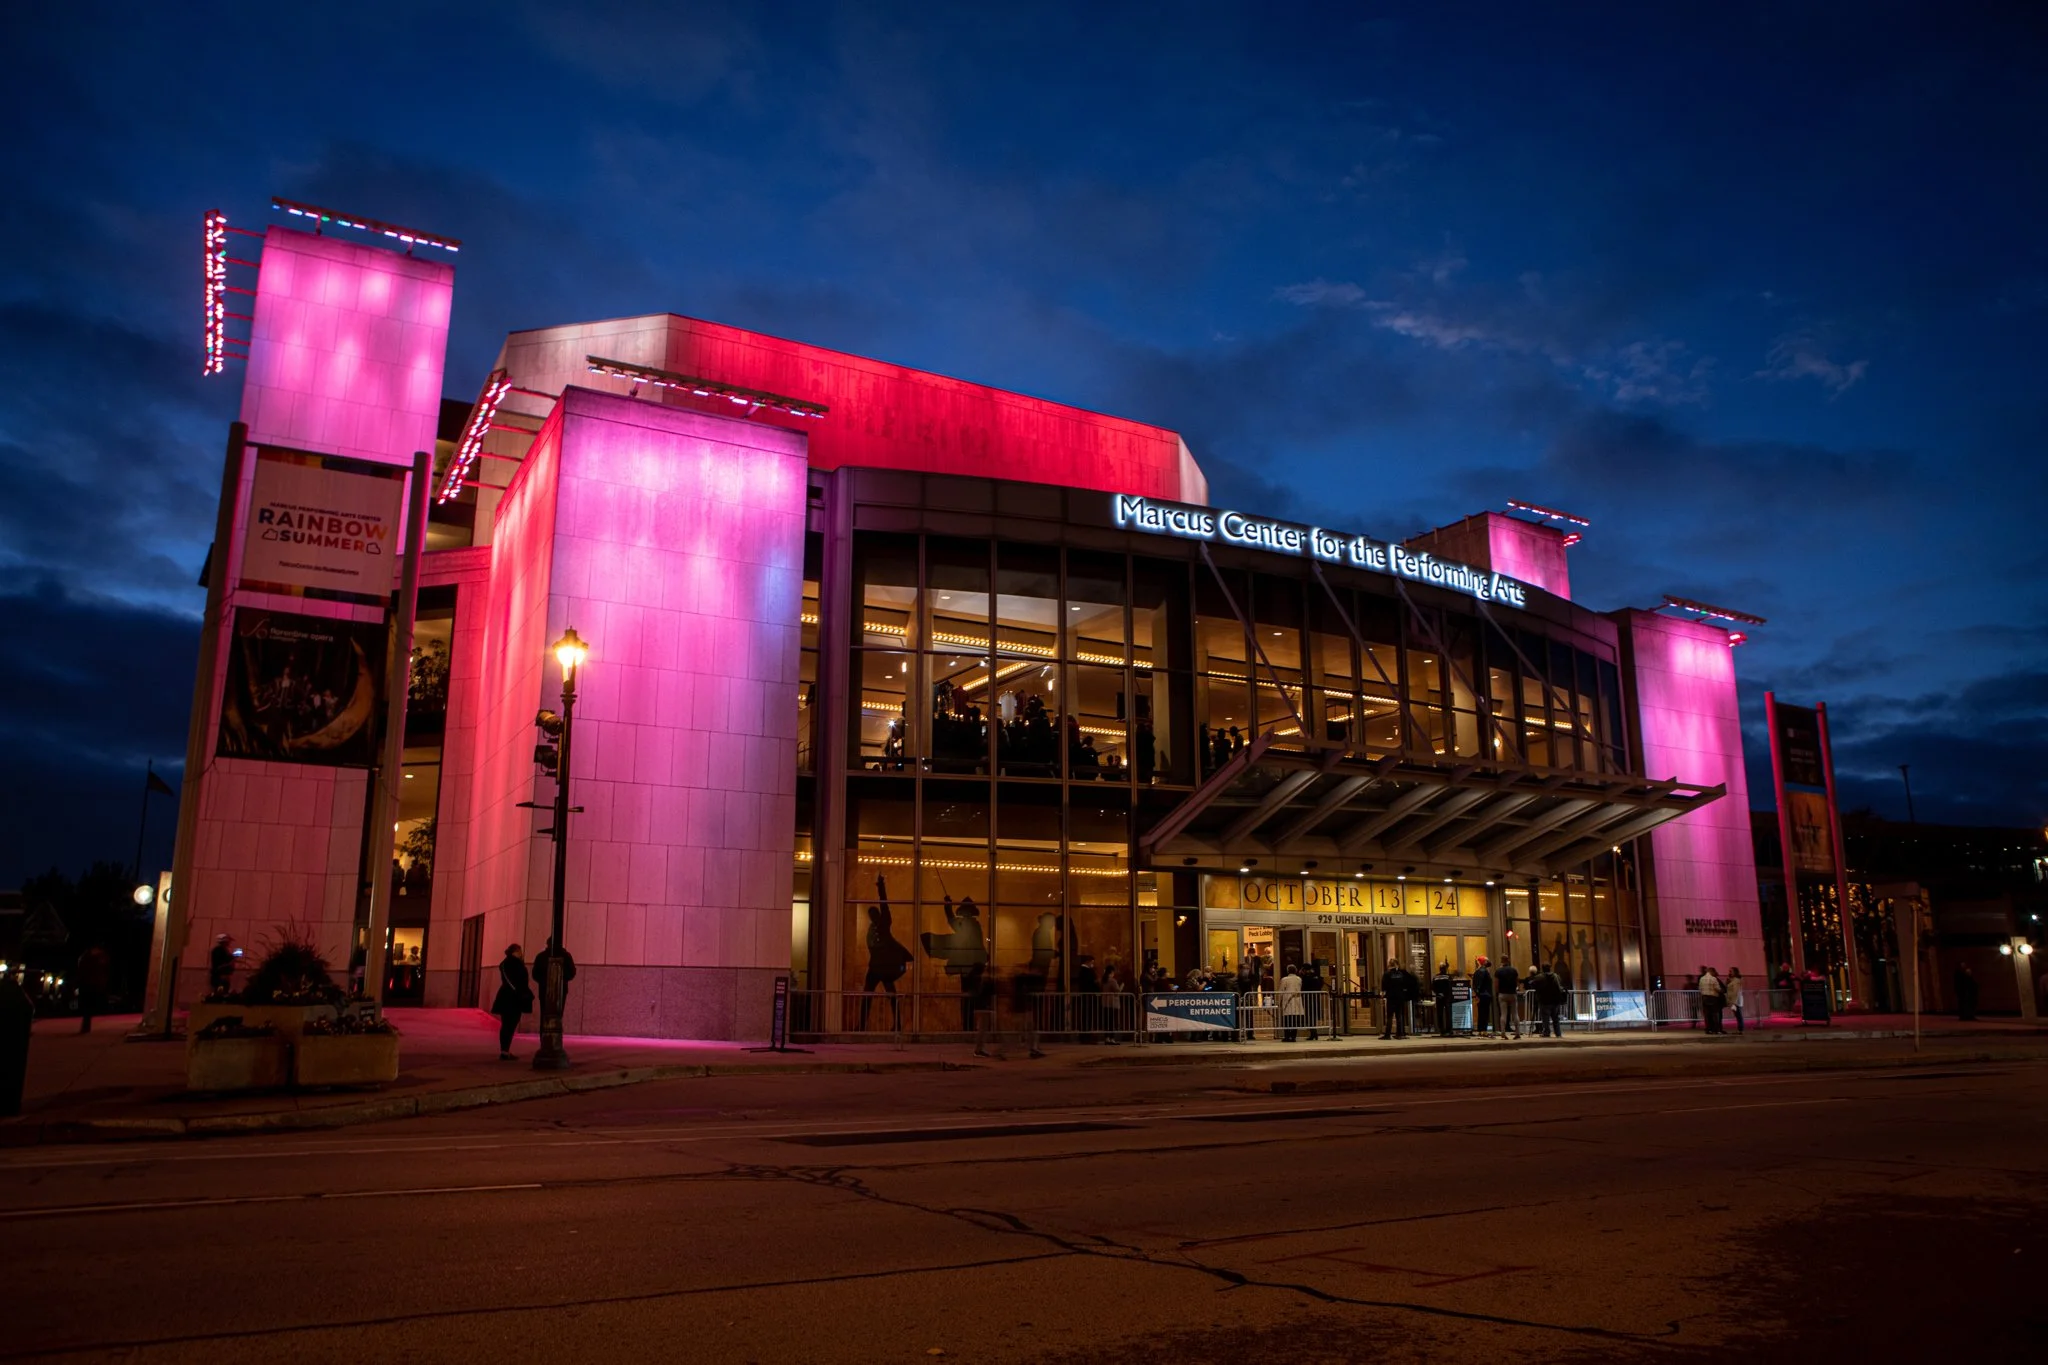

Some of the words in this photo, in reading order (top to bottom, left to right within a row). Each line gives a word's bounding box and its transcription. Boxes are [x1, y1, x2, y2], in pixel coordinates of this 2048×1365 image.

[258, 508, 388, 540] RAINBOW
[279, 529, 365, 553] SUMMER
[1117, 493, 1216, 535] Marcus
[1220, 511, 1309, 551] Center
[1314, 528, 1346, 557] for
[1352, 537, 1388, 567] the
[1391, 546, 1491, 599] Performing
[1492, 574, 1527, 605] Arts
[1244, 882, 1363, 908] OCTOBER
[1379, 888, 1401, 909] 13
[1434, 890, 1456, 911] 24
[1318, 914, 1333, 924] 929
[1335, 915, 1370, 926] UIHLEIN
[1372, 916, 1395, 926] HALL
[1168, 998, 1231, 1007] PERFORMANCE
[1189, 1007, 1231, 1016] ENTRANCE
